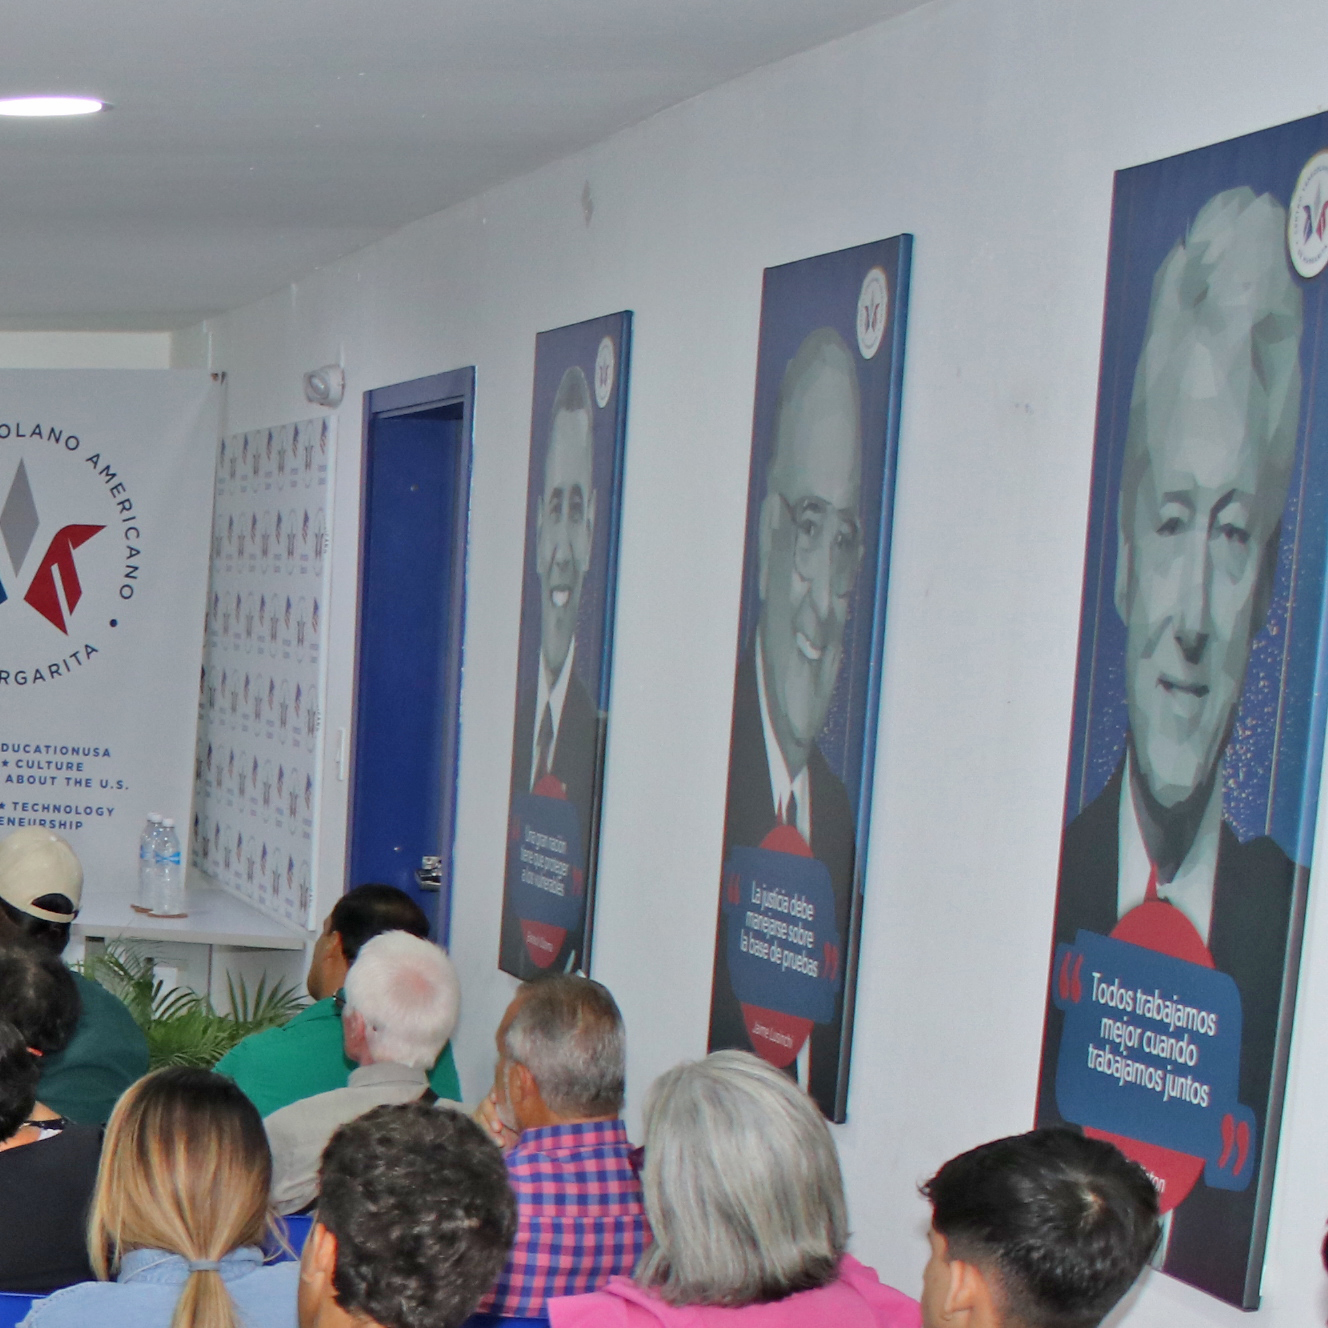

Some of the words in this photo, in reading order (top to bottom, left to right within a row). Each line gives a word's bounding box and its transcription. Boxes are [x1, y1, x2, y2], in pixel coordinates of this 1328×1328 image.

[85, 452, 141, 600] AMERICANO
[5, 773, 58, 786] ABOUT
[65, 776, 93, 788] THE
[100, 779, 129, 791] U.S.
[15, 759, 84, 772] CULTURE
[12, 801, 115, 817] TECHNOLOGY
[751, 880, 761, 904] La
[761, 883, 789, 913] justicia
[789, 893, 815, 921] debe
[746, 911, 787, 939] manejarse
[788, 921, 815, 949] sobre
[740, 928, 748, 952] la
[749, 931, 770, 960] base
[770, 940, 781, 964] de
[782, 948, 819, 978] pruebas
[1092, 971, 1134, 1013] Todos
[1136, 988, 1217, 1037] trabajamos
[1100, 1015, 1142, 1051] mejor
[1143, 1032, 1198, 1067] cuando
[1087, 1042, 1163, 1092] trabajamos
[1163, 1064, 1211, 1108] juntos
